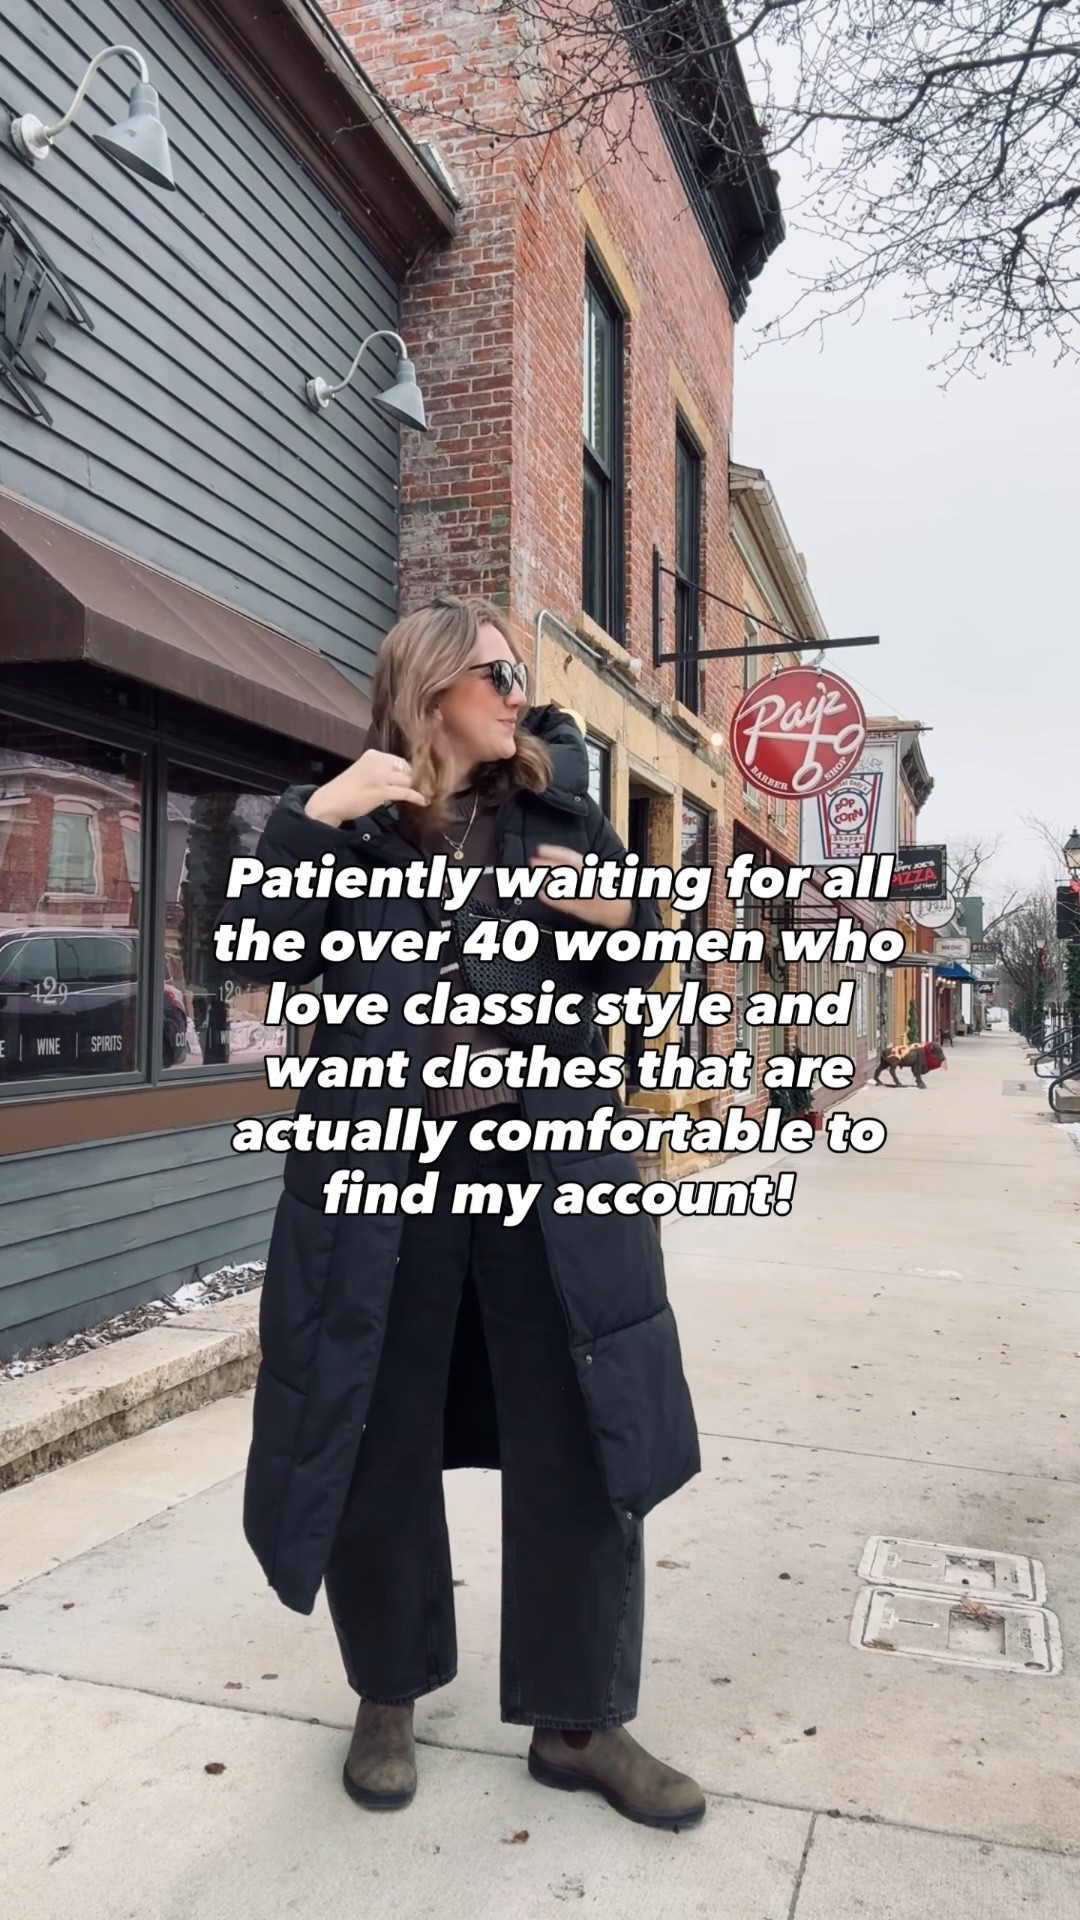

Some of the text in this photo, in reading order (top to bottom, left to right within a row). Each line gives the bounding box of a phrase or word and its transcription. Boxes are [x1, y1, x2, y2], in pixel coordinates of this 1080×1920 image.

[750, 756, 847, 791] BARBER SHOP
[835, 797, 855, 812] POP
[834, 808, 863, 824] CORN
[33, 975, 69, 1006] 129
[36, 1034, 123, 1056] WINE SPIRITS
